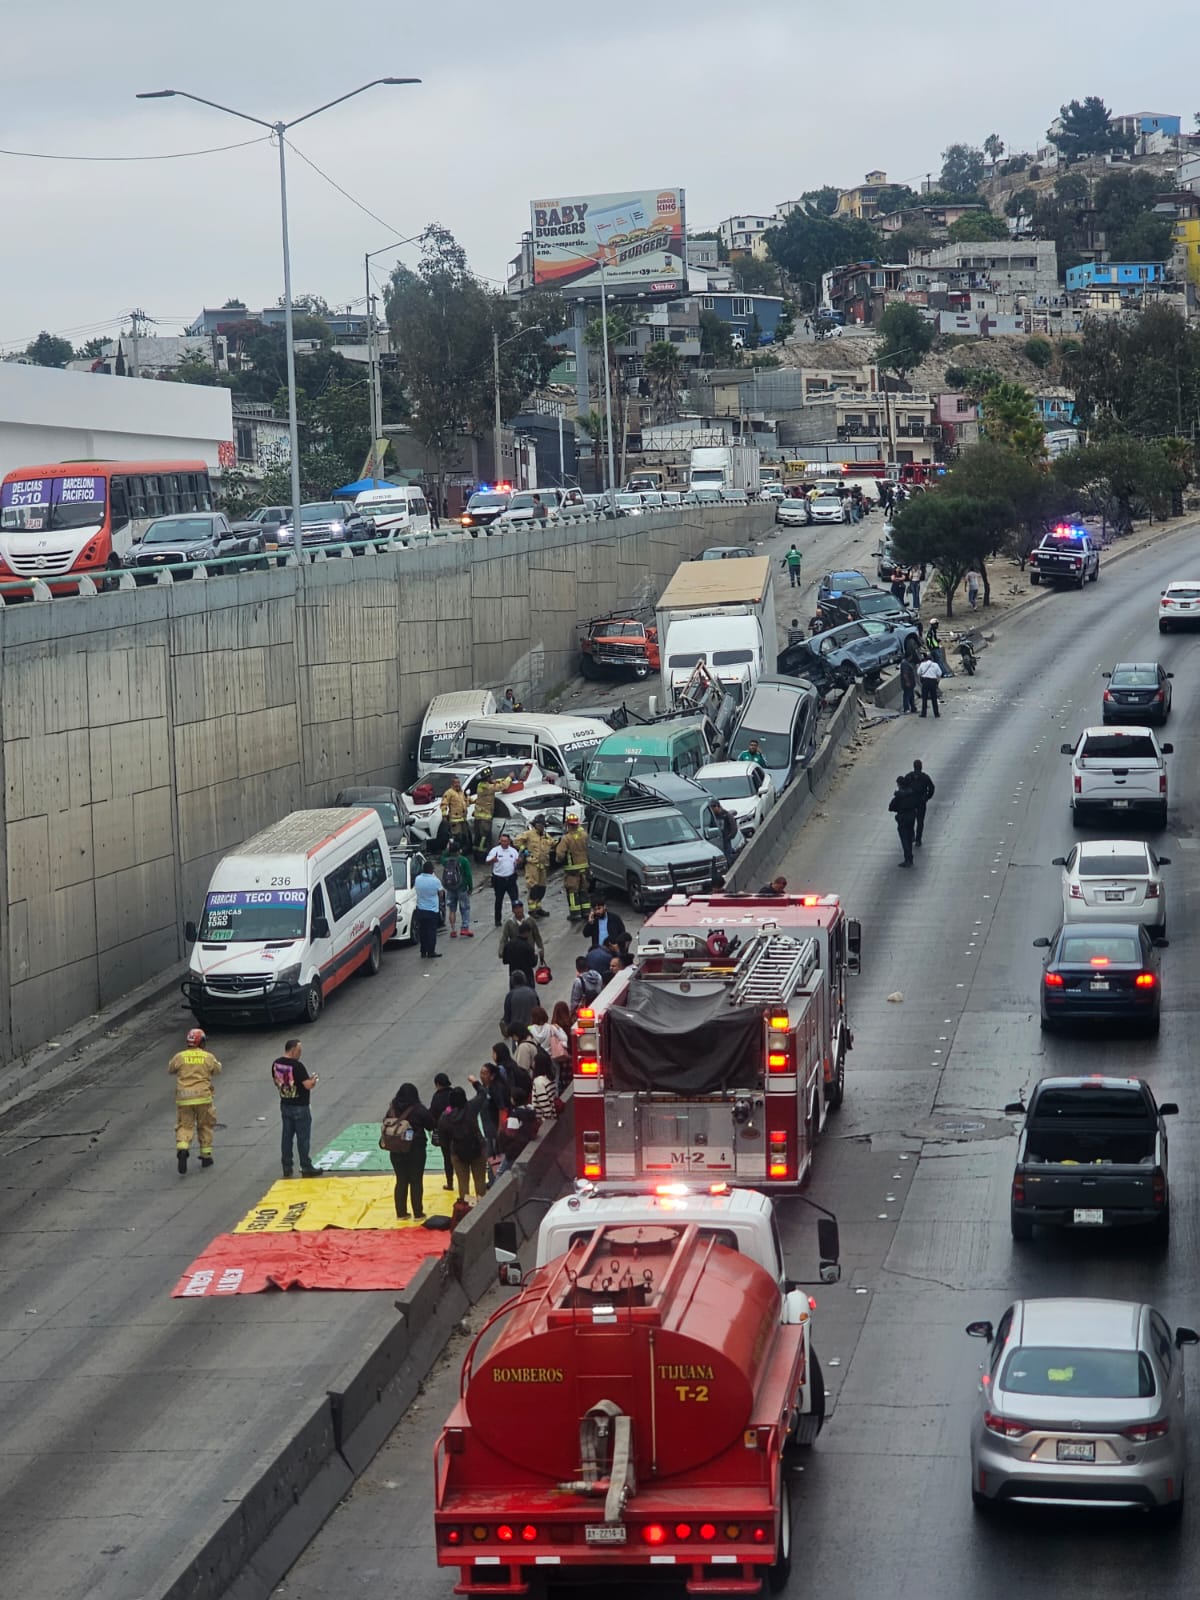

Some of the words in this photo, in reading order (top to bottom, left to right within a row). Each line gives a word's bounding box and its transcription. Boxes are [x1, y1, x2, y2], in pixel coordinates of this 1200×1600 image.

[657, 203, 676, 211] KING
[535, 203, 588, 227] BABY
[536, 222, 586, 238] BURGERS
[619, 234, 669, 262] BURGERS
[12, 480, 43, 494] DELICIAS
[63, 478, 95, 489] BARCELONA
[62, 489, 95, 501] PACIFICO
[270, 877, 291, 886] 236
[244, 892, 272, 903] TECO
[277, 891, 306, 902] TORO
[671, 1152, 705, 1163] M-2
[493, 1368, 564, 1382] BOMBEROS
[658, 1365, 714, 1379] TIJUANA
[675, 1386, 709, 1401] T-2
